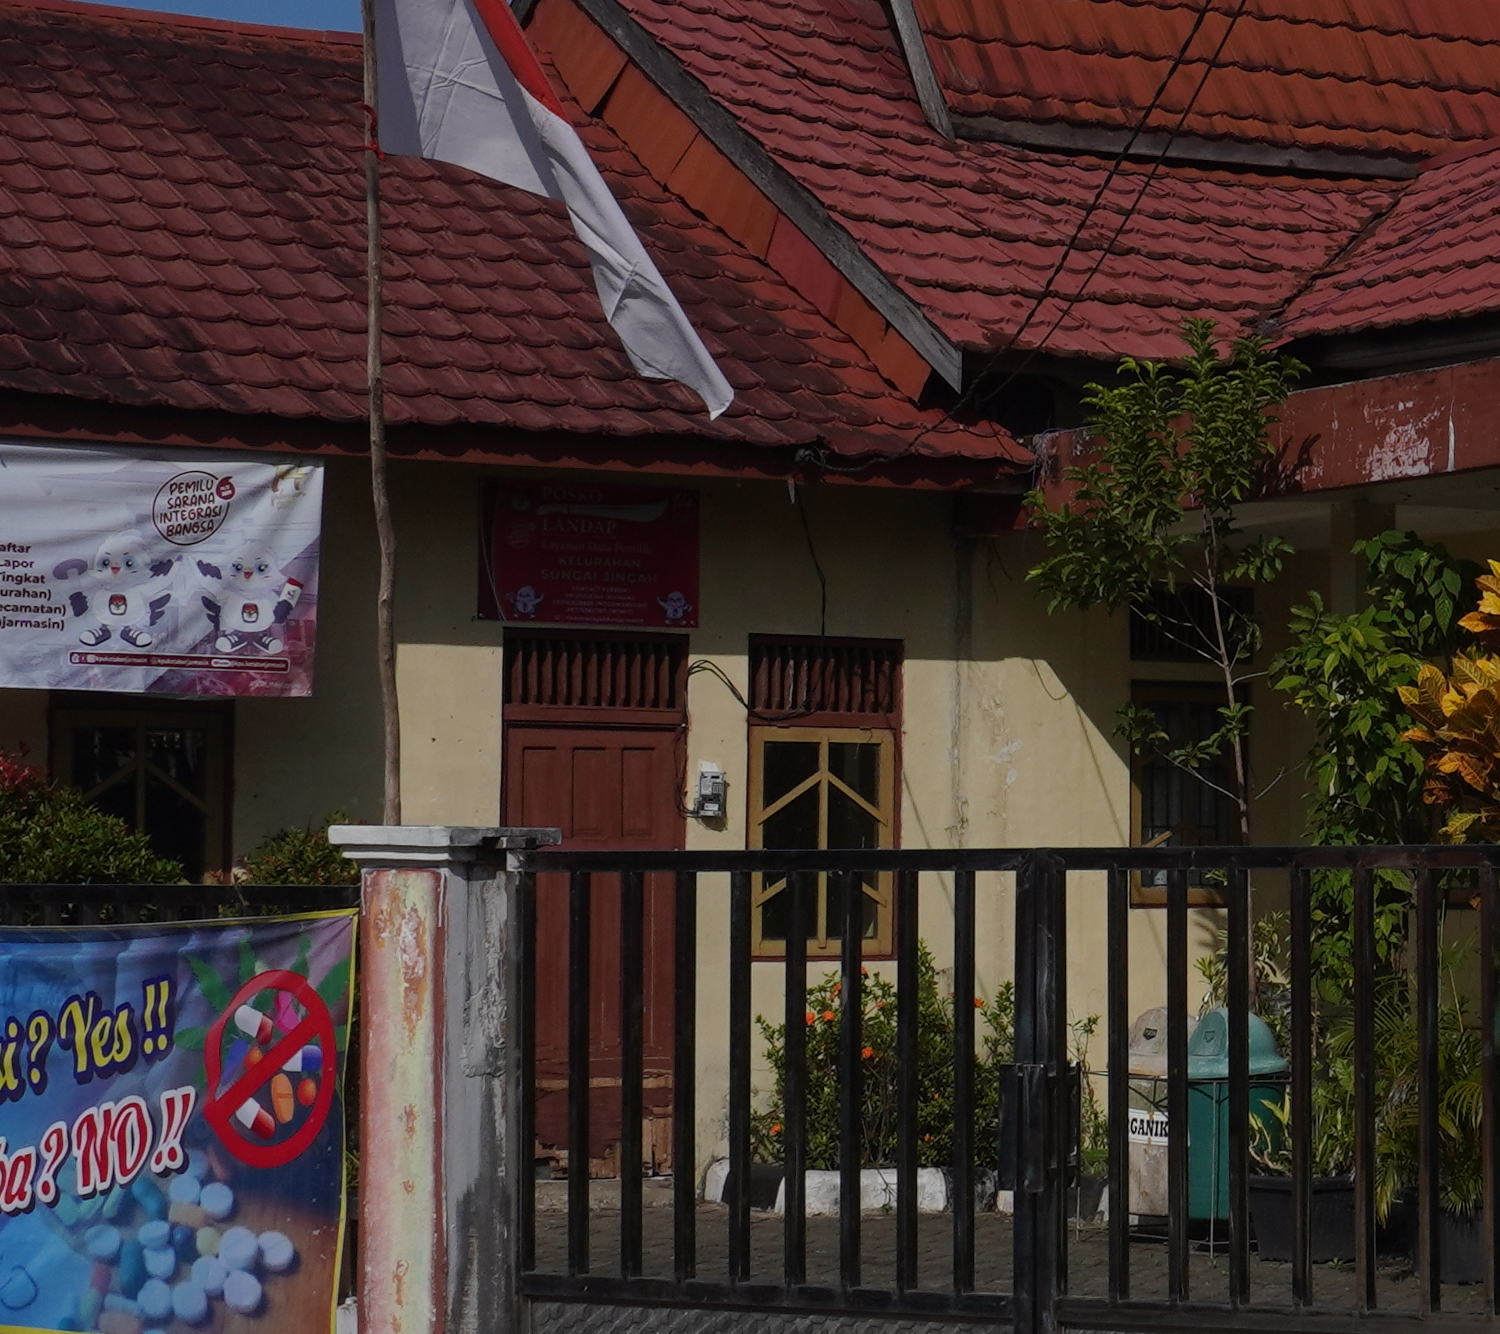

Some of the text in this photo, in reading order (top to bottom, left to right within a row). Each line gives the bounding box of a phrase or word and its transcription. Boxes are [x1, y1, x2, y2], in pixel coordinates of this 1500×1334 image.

[170, 479, 214, 495] PEMILU
[542, 486, 603, 503] POSKO
[167, 492, 215, 510] SARANA
[160, 505, 223, 524] INTEGRASI
[166, 519, 215, 537] BANGSA
[542, 517, 617, 534] LANDAP
[558, 556, 641, 568] KELURAHAN
[540, 569, 658, 583] SUNGAI JINGAH
[59, 996, 134, 1074] Yes
[1128, 1118, 1169, 1137] GANIK
[74, 1098, 151, 1192] NO
